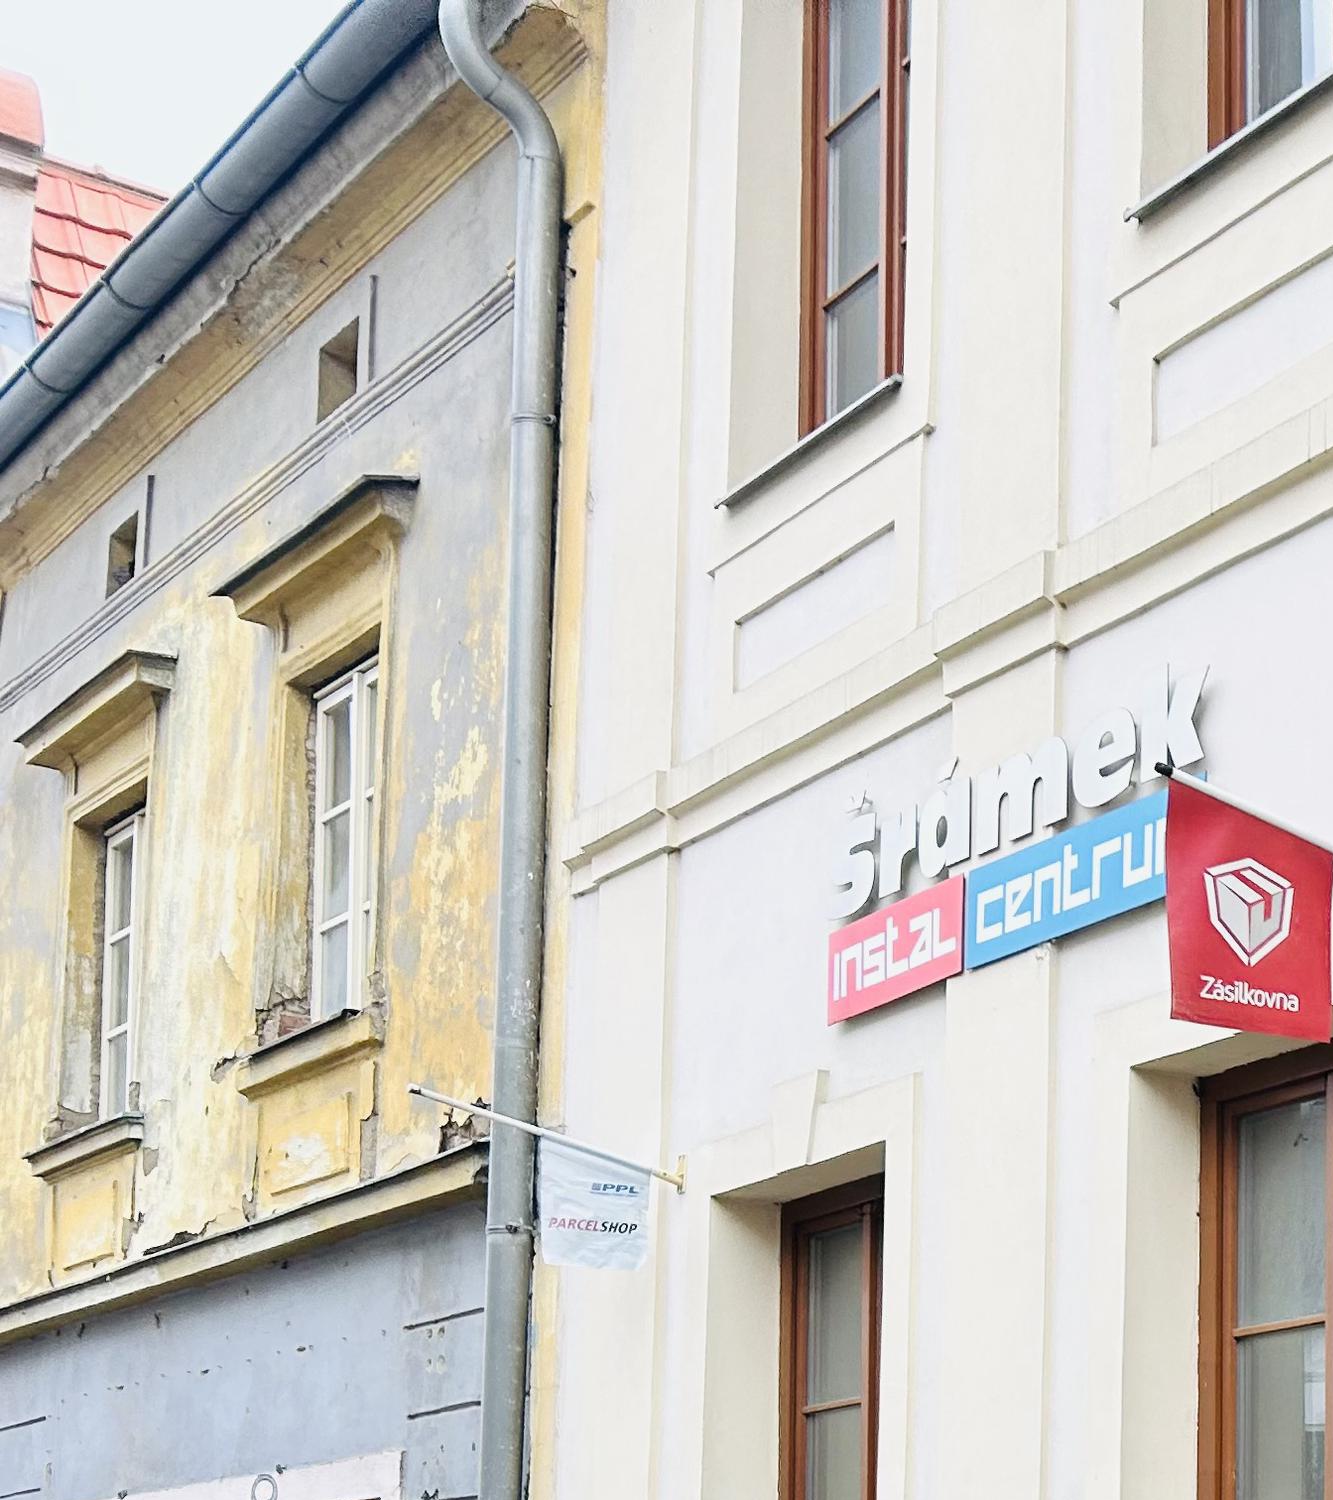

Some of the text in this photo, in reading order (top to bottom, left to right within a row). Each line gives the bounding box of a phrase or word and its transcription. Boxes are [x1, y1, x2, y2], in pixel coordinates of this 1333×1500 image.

[827, 663, 1210, 920] Šrámek
[1200, 974, 1300, 1012] Zásilkovna
[548, 1217, 639, 1234] PARCELSHOP
